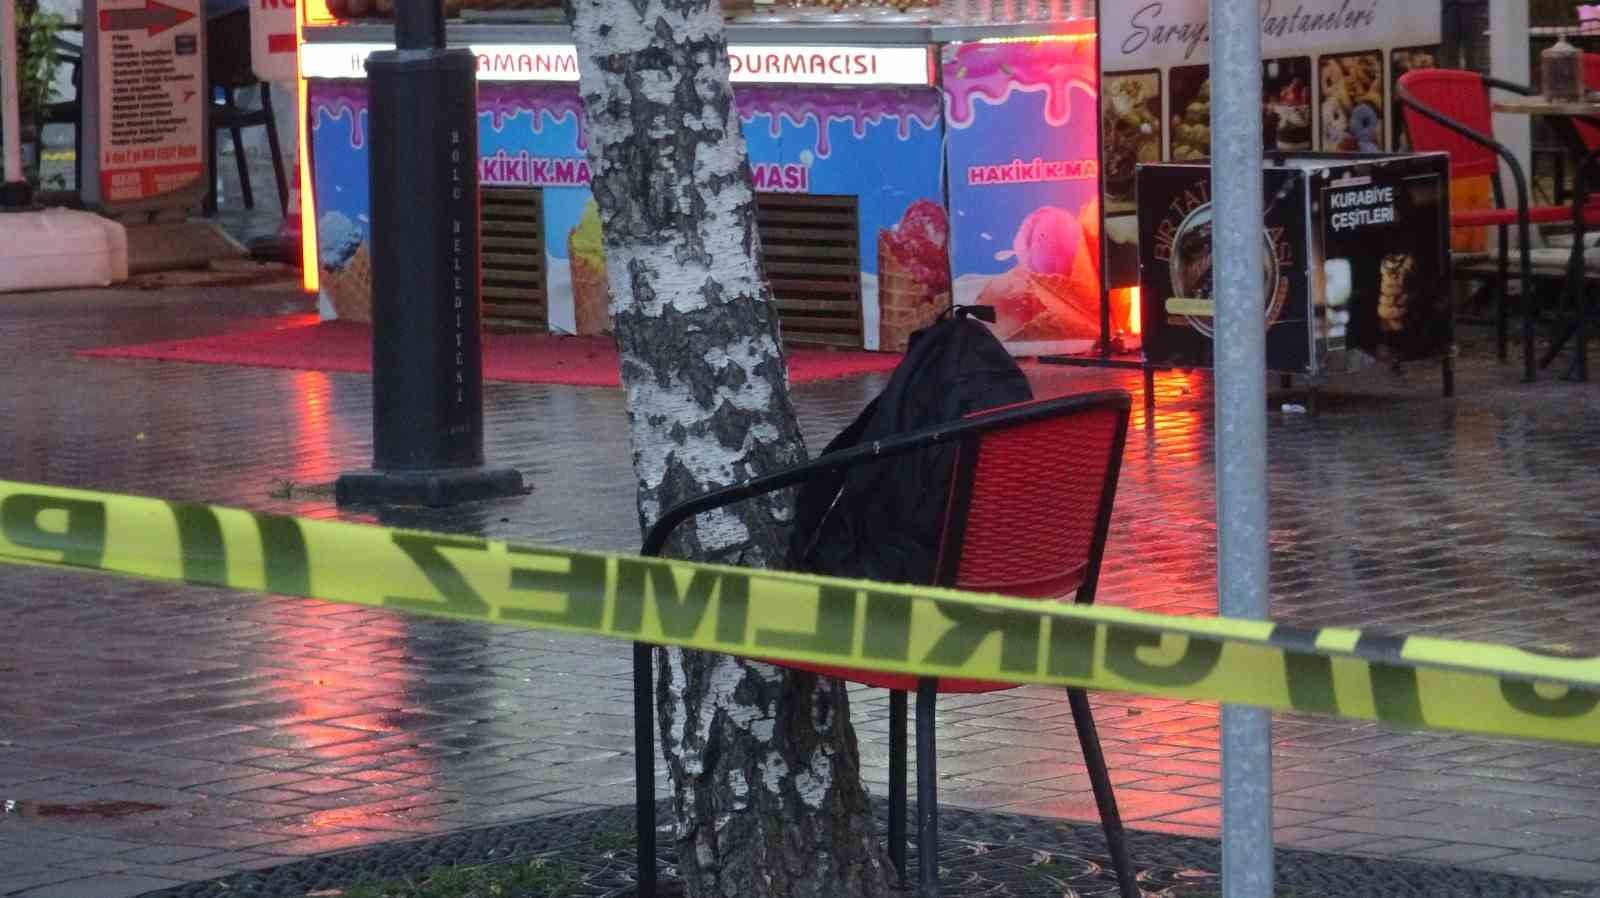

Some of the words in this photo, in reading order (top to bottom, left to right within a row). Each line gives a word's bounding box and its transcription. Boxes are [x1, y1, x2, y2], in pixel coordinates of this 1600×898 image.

[1121, 2, 1209, 59] Saray
[477, 54, 577, 73] AMANM
[728, 53, 877, 74] DURMACISI
[480, 150, 529, 182] KİKİ
[533, 160, 592, 182] K.MA
[752, 165, 806, 189] MASI
[970, 158, 1043, 183] HAKİKİ
[1330, 185, 1393, 209] KURABİYE
[1330, 204, 1394, 233] ÇEŞİTLERİ
